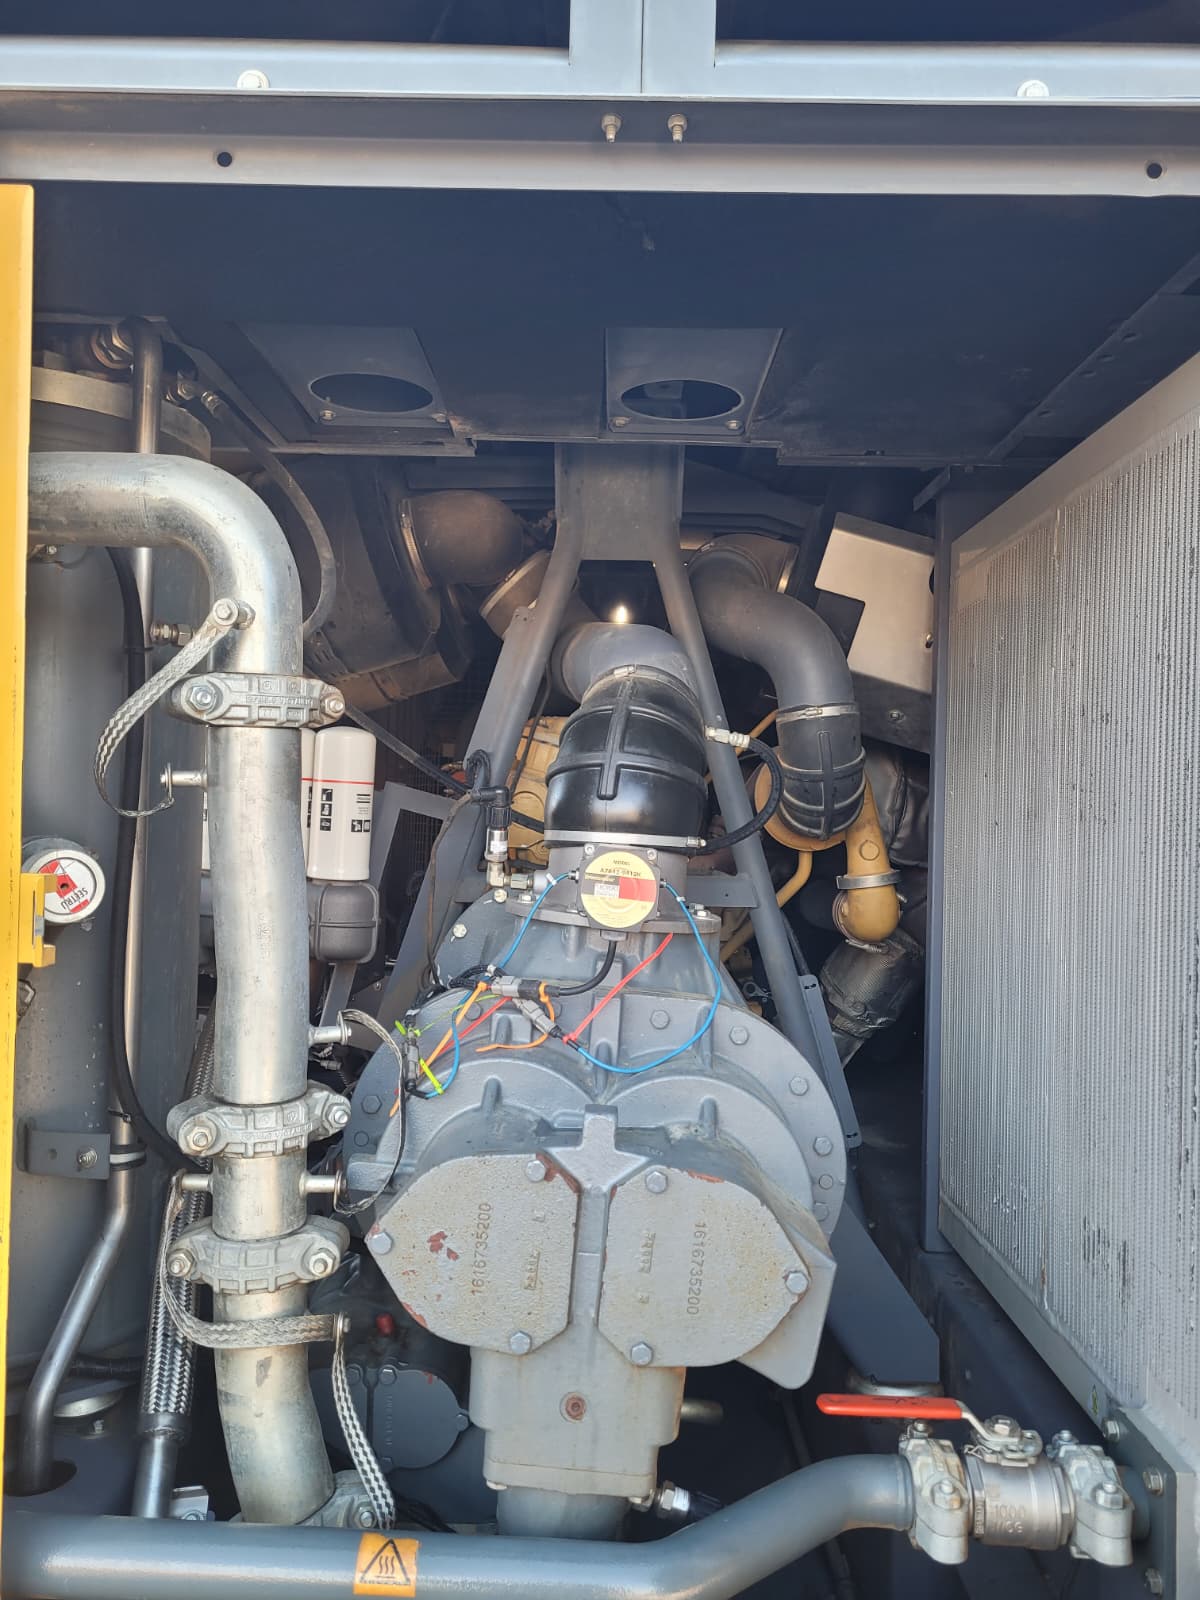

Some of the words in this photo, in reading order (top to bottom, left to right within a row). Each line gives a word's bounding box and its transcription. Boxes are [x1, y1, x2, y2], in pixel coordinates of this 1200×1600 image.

[60, 888, 88, 910] SEETRU
[470, 1202, 492, 1297] 1616735200
[686, 1222, 707, 1315] 1616735200
